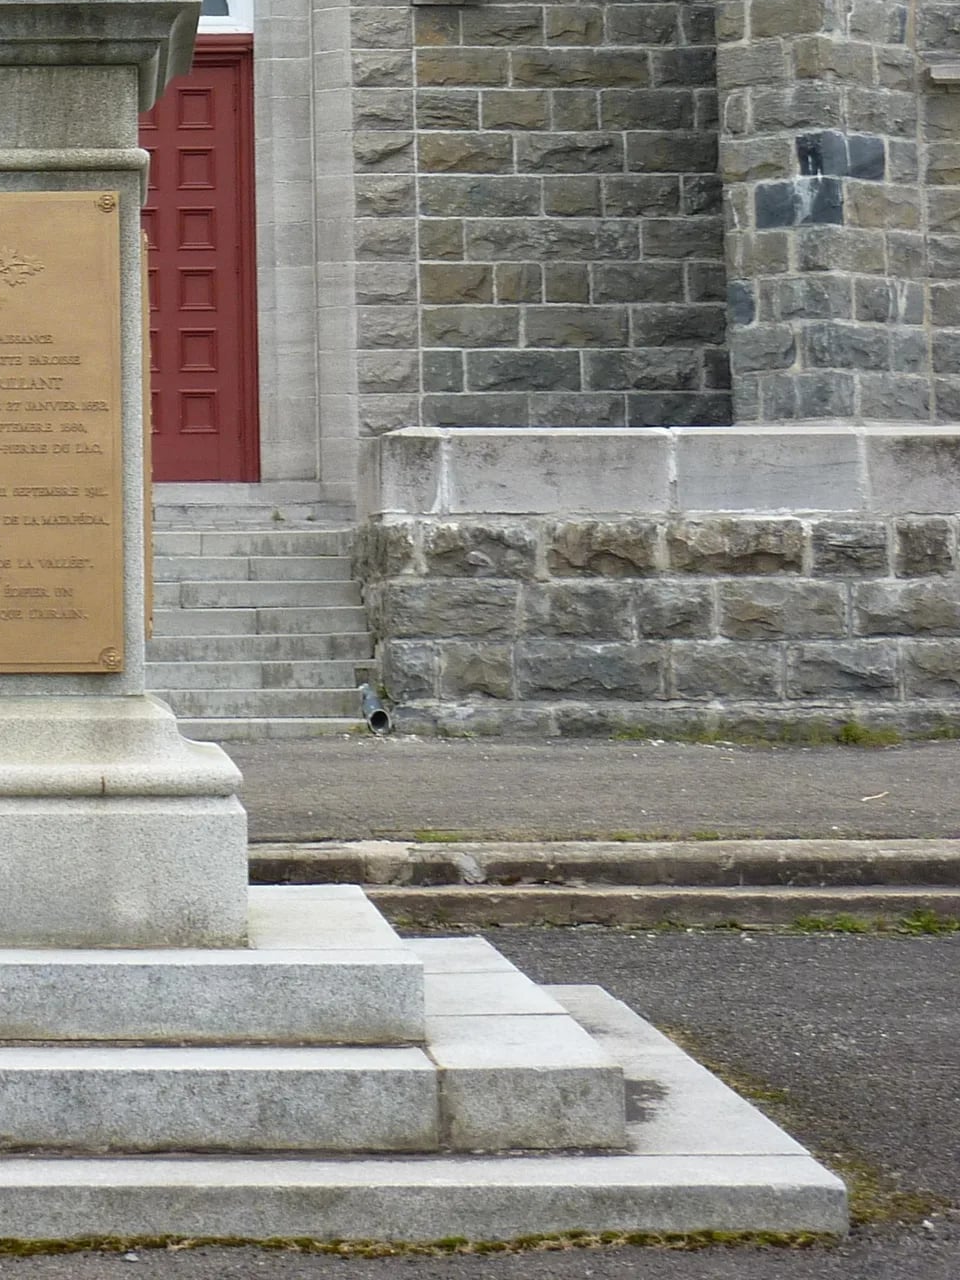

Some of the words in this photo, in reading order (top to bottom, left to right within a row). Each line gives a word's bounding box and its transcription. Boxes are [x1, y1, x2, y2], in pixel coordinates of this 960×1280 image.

[29, 355, 81, 366] PAROISSE
[25, 401, 79, 412] JANVIER
[52, 444, 70, 454] DU
[13, 487, 79, 497] SEPTEMBRE
[4, 516, 19, 526] DE
[24, 515, 40, 526] LA
[17, 558, 34, 569] LA
[54, 587, 73, 598] UN
[0, 608, 23, 620] QUE
